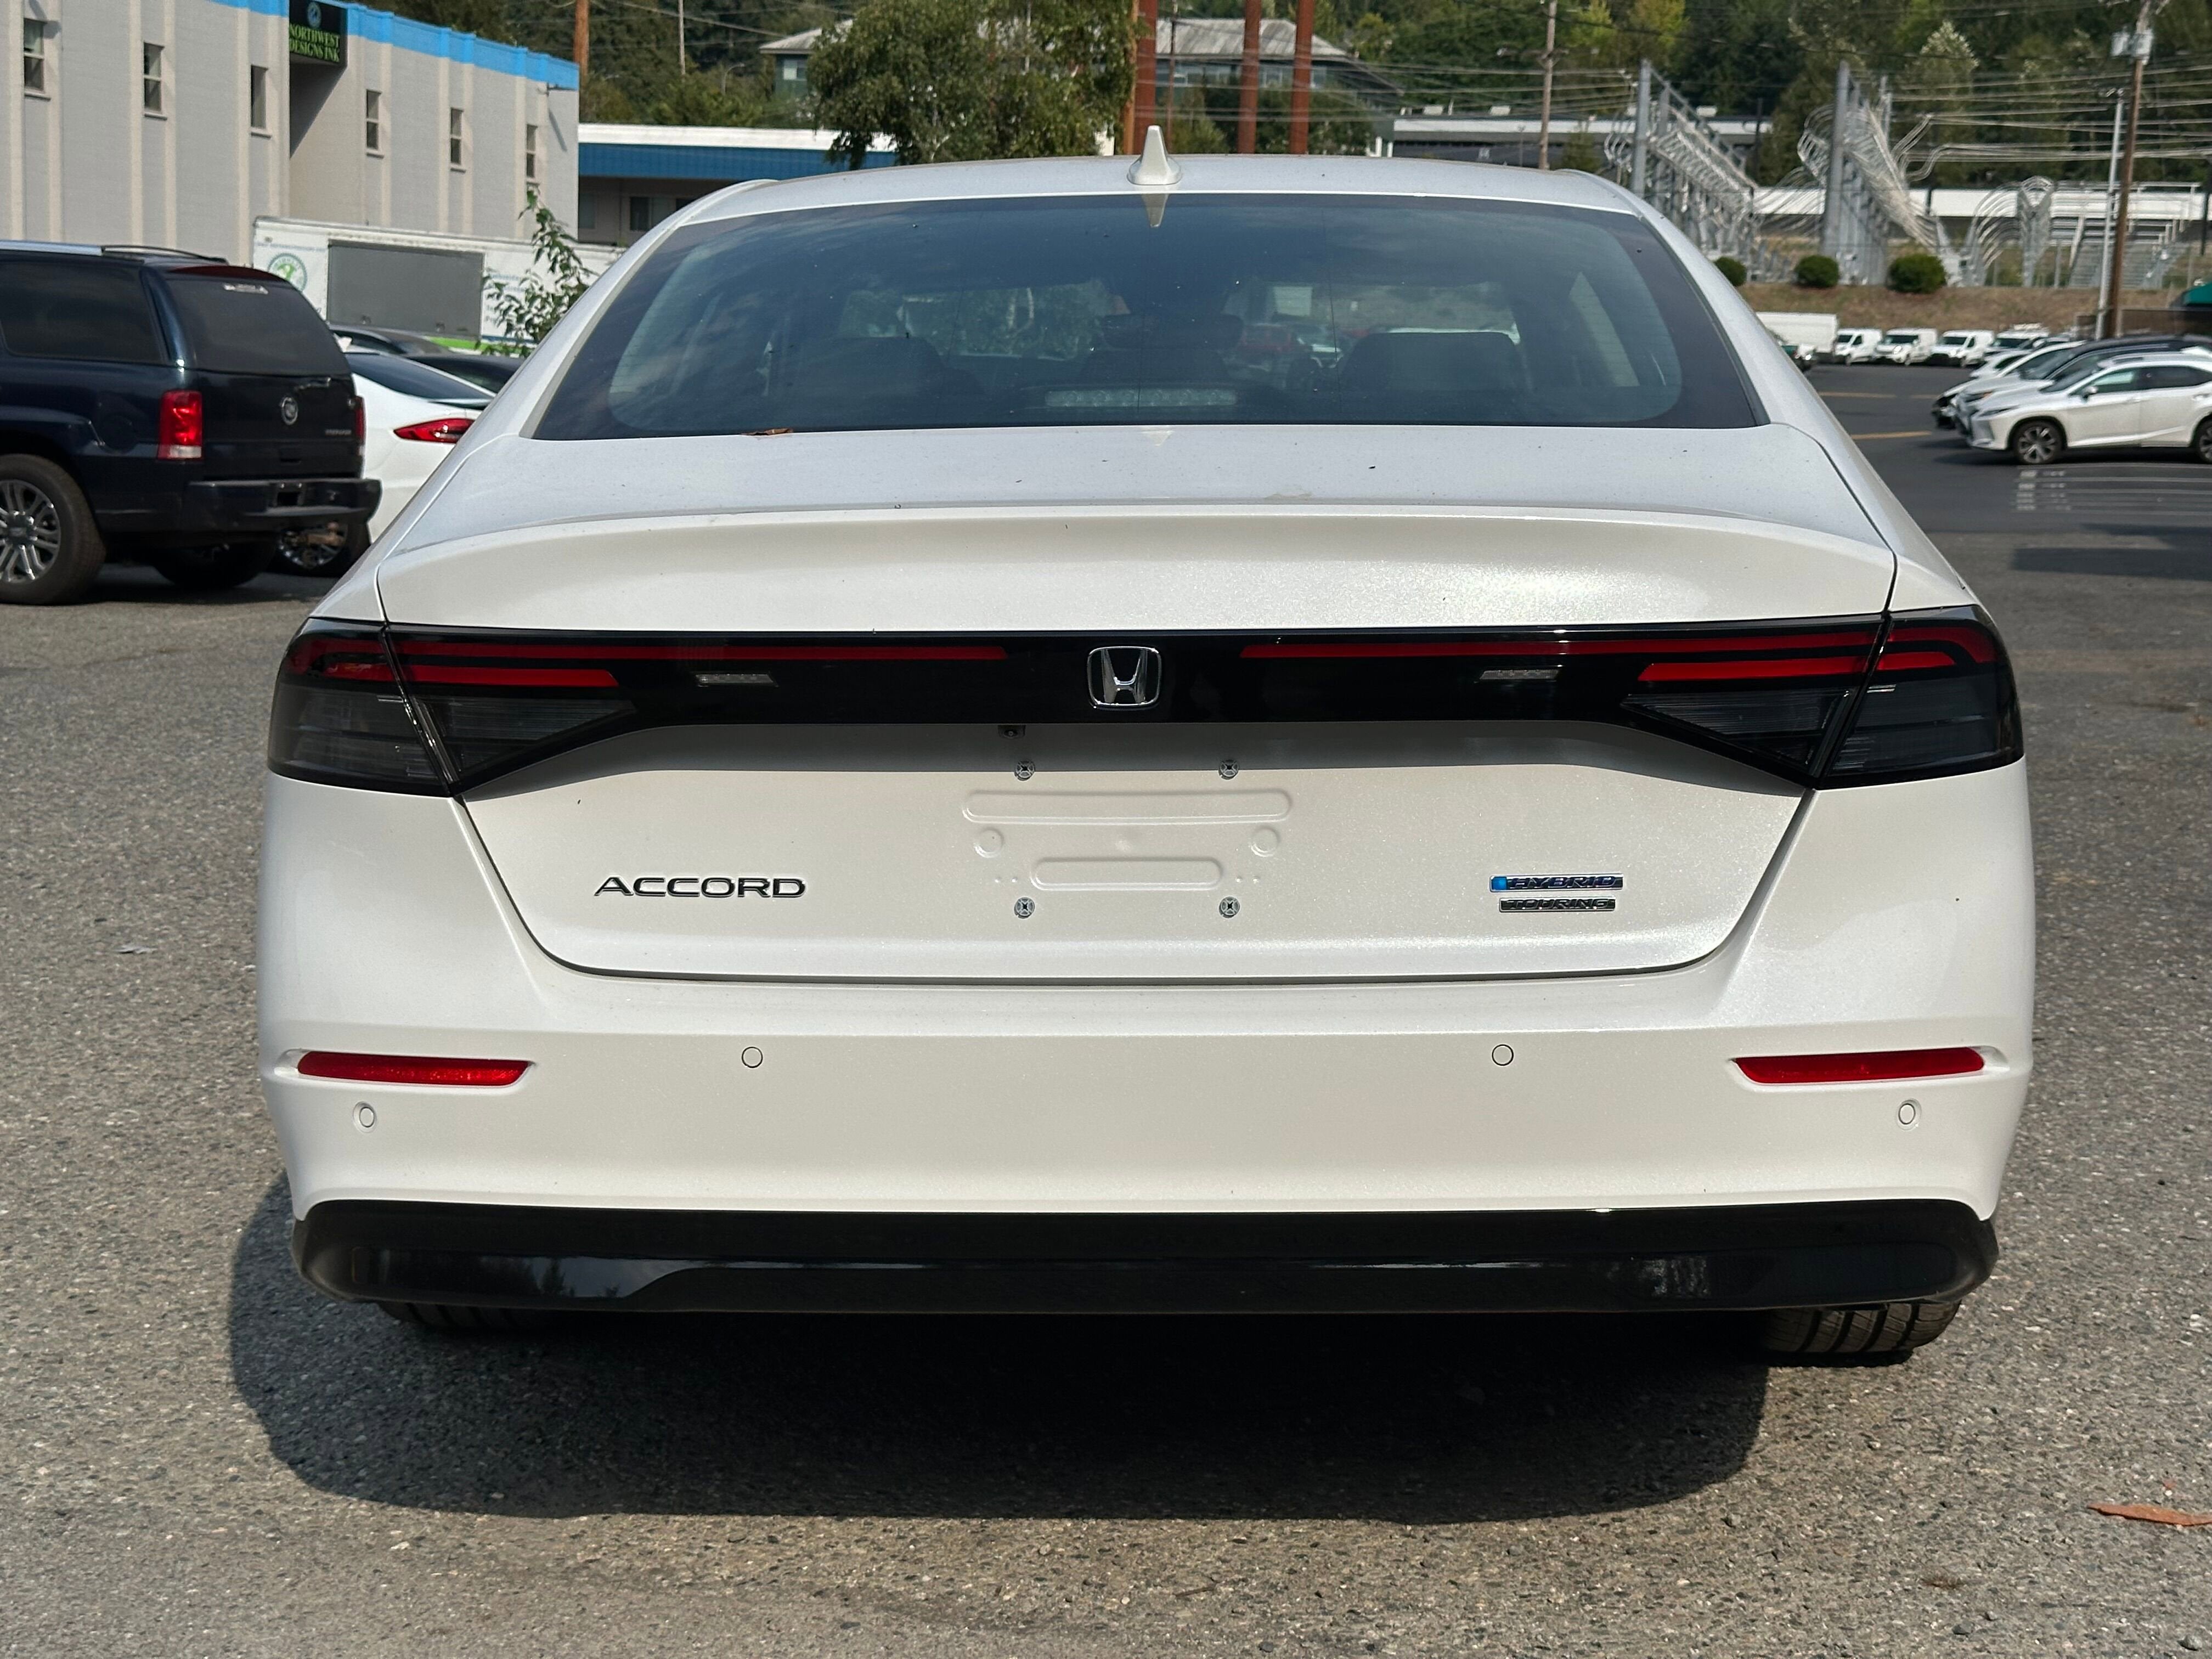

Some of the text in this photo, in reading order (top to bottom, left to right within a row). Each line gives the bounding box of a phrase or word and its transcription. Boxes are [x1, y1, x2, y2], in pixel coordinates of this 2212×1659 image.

[289, 23, 339, 48] NORTHWEST
[289, 38, 340, 62] DESIGNS INK
[594, 876, 806, 898] ACCORD
[1509, 876, 1617, 889] HYBRID
[1505, 899, 1611, 910] TOURING
